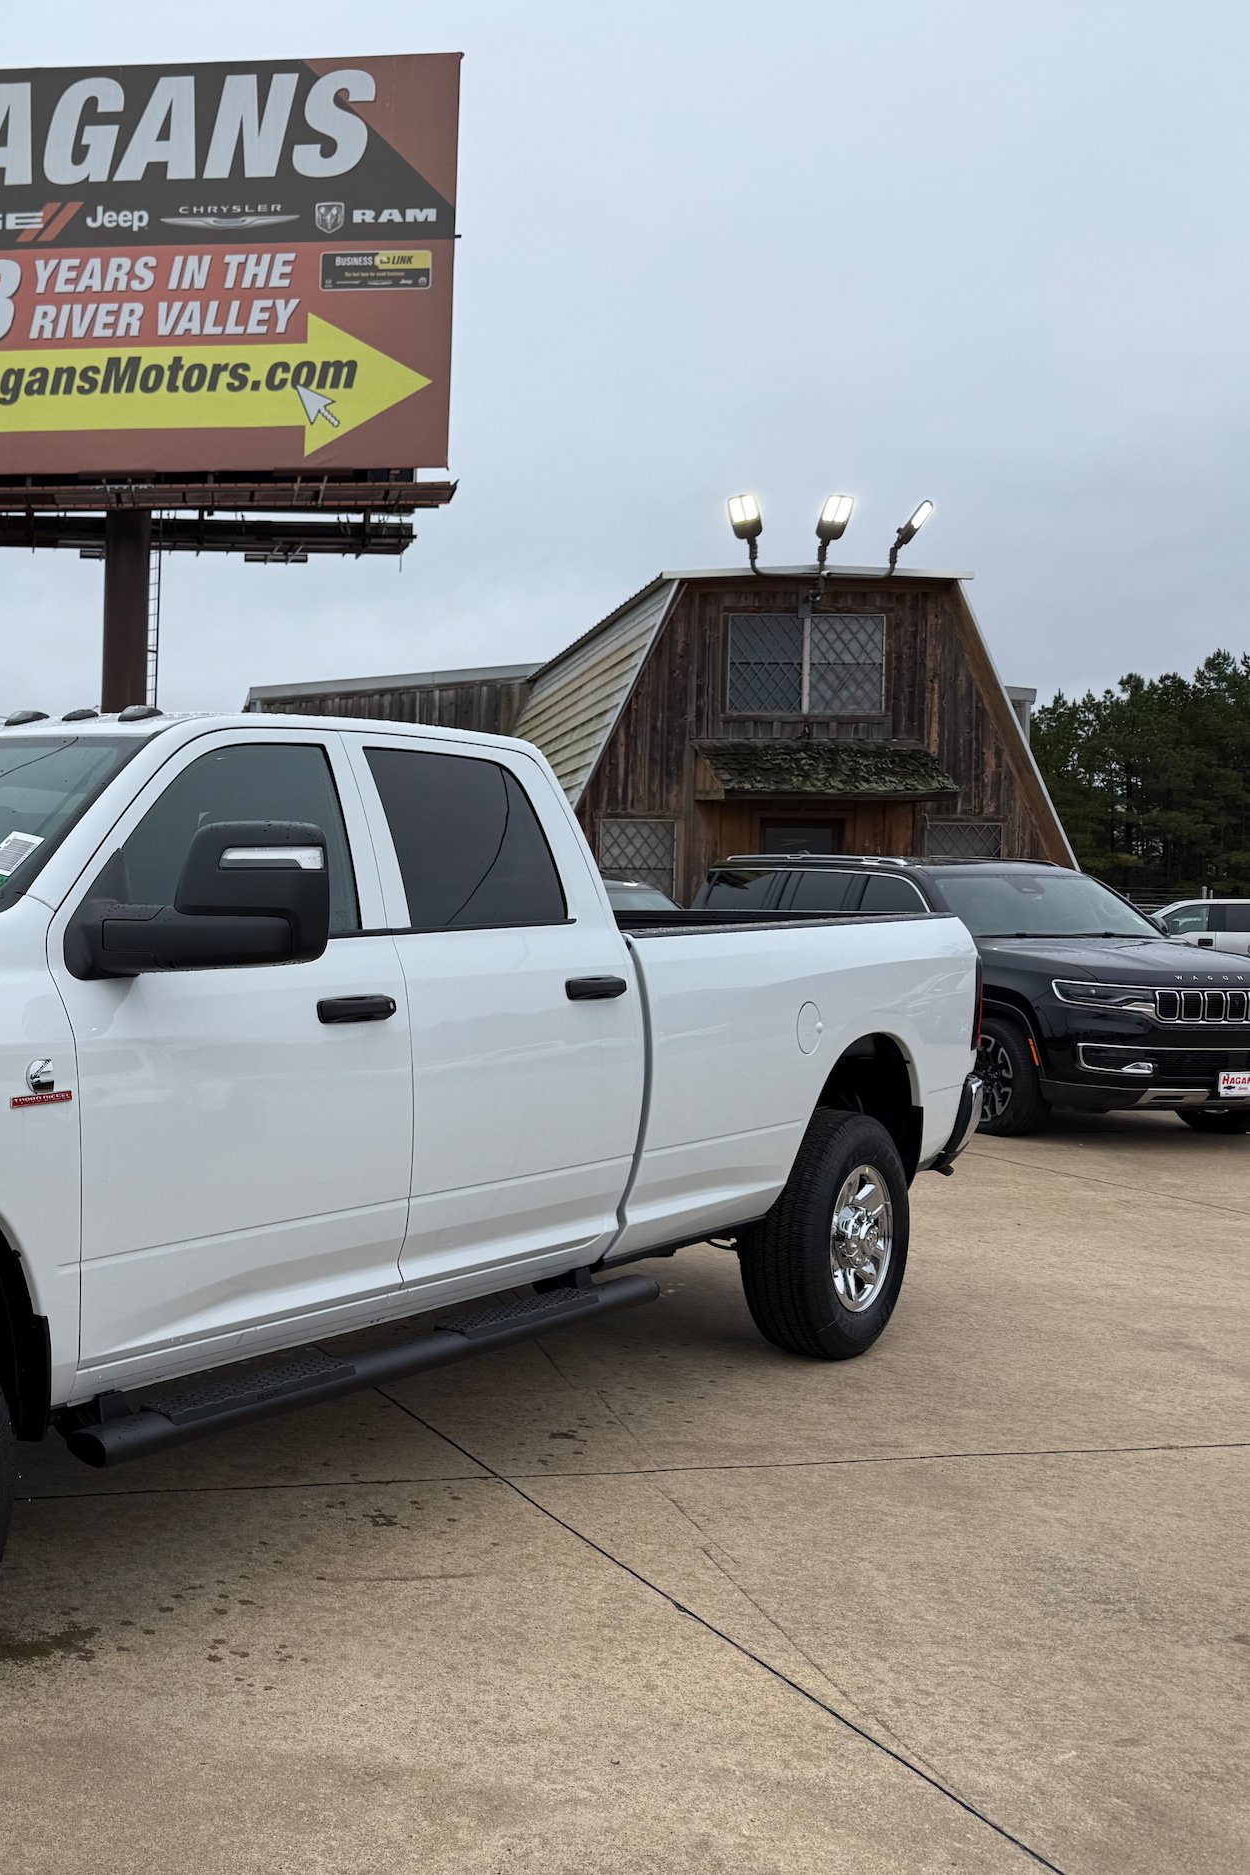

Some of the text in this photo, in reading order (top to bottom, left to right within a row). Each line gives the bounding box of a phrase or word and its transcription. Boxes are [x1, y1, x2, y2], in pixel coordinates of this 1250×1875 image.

[86, 205, 149, 232] Jeep
[178, 203, 283, 215] CHRYSLER
[352, 208, 437, 224] RAM
[391, 255, 414, 265] LINK
[35, 252, 298, 295] YEARS IN THE
[29, 298, 300, 340] RIVER VALLEY
